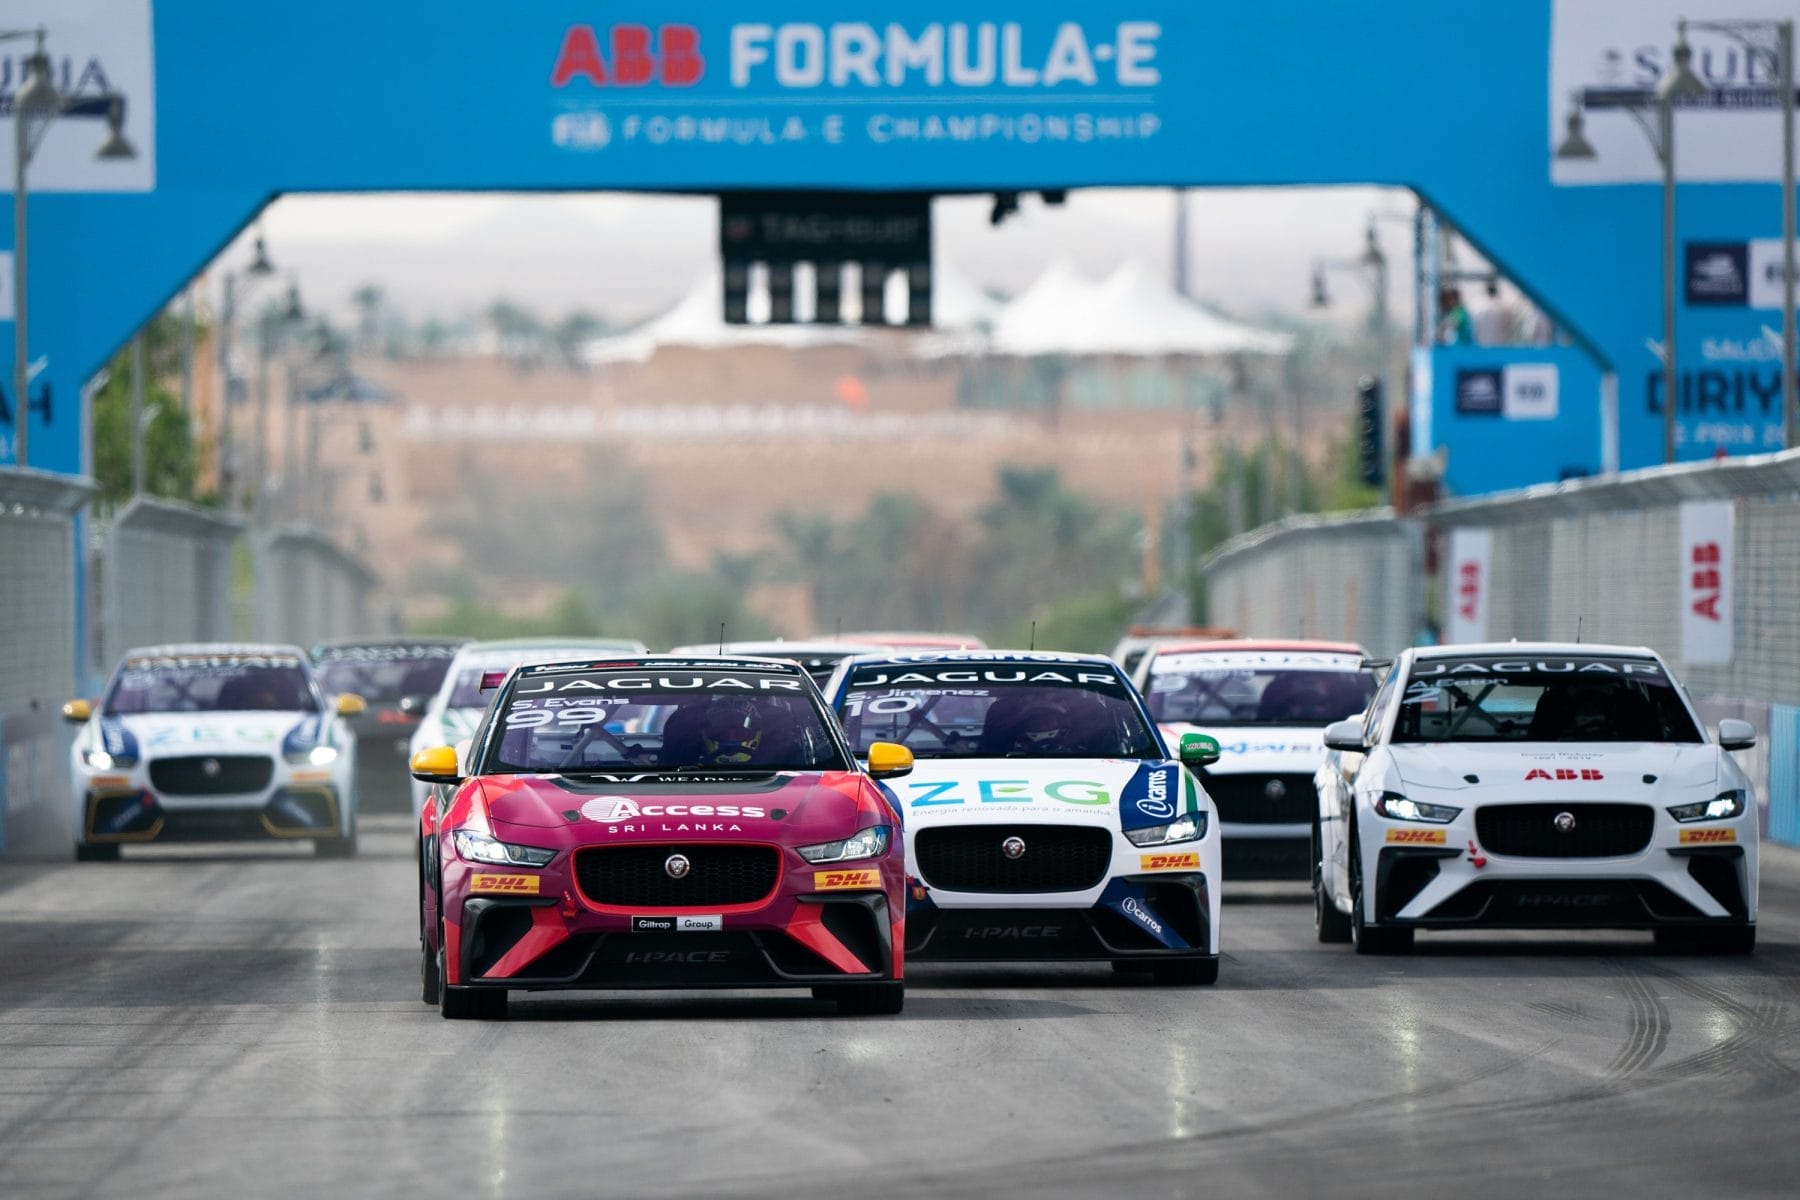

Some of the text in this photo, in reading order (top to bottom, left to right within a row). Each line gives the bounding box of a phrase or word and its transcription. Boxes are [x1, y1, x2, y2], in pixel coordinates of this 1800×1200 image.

[552, 24, 704, 88] ABB
[868, 112, 1162, 143] CHAMPIONSHIP
[1692, 542, 1720, 622] ABB
[1414, 662, 1658, 676] JAGUAR
[853, 671, 1117, 686] JAGUAR
[518, 677, 802, 694] JAGUAR
[886, 688, 990, 698] Jimenez
[511, 697, 630, 710] S. Evans
[844, 697, 917, 717] 10
[506, 707, 607, 730] 99
[1524, 768, 1605, 781] ABB
[909, 780, 1112, 807] ZEG
[608, 801, 766, 818] Access
[608, 823, 742, 833] SRI LANKA
[1395, 832, 1436, 841] DHL
[1689, 831, 1729, 841] DHL
[1150, 855, 1193, 868] DHL
[478, 877, 529, 890] DHL
[825, 872, 873, 887] DHL
[638, 919, 713, 929] Giltrap Group
[965, 926, 1062, 938] I-PACE
[626, 951, 730, 963] I-PACE
